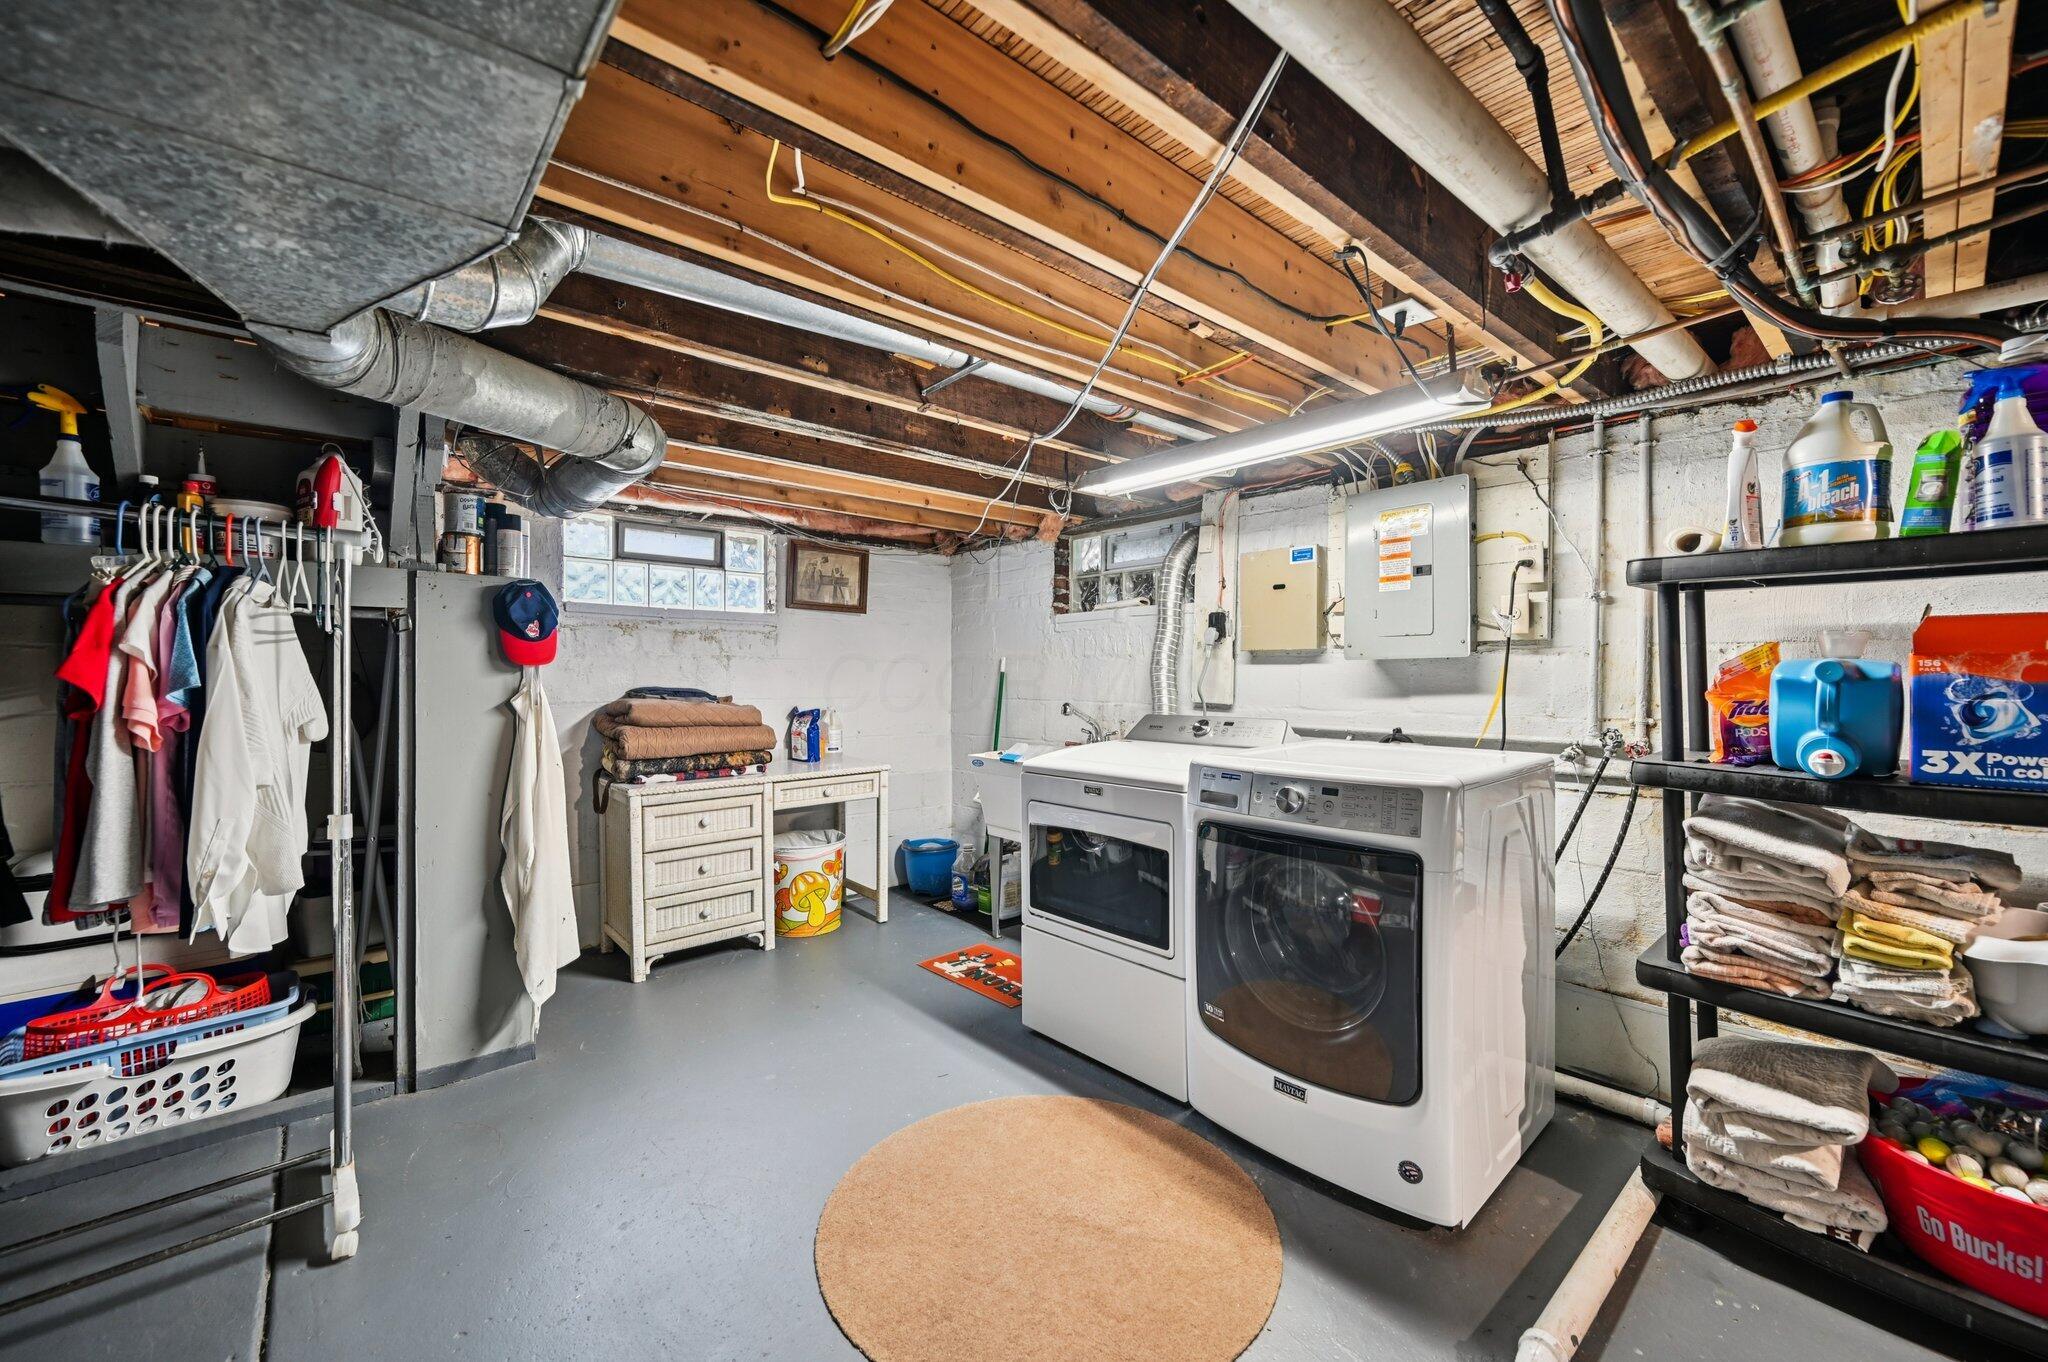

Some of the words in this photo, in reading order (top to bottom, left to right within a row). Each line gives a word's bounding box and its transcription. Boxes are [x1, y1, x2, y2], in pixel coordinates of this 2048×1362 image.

[1917, 659, 1942, 667] 156
[1735, 727, 1769, 738] PODS
[1919, 749, 1986, 777] 3X
[1987, 764, 2006, 777] in
[1274, 1079, 1306, 1099] MAYTAG
